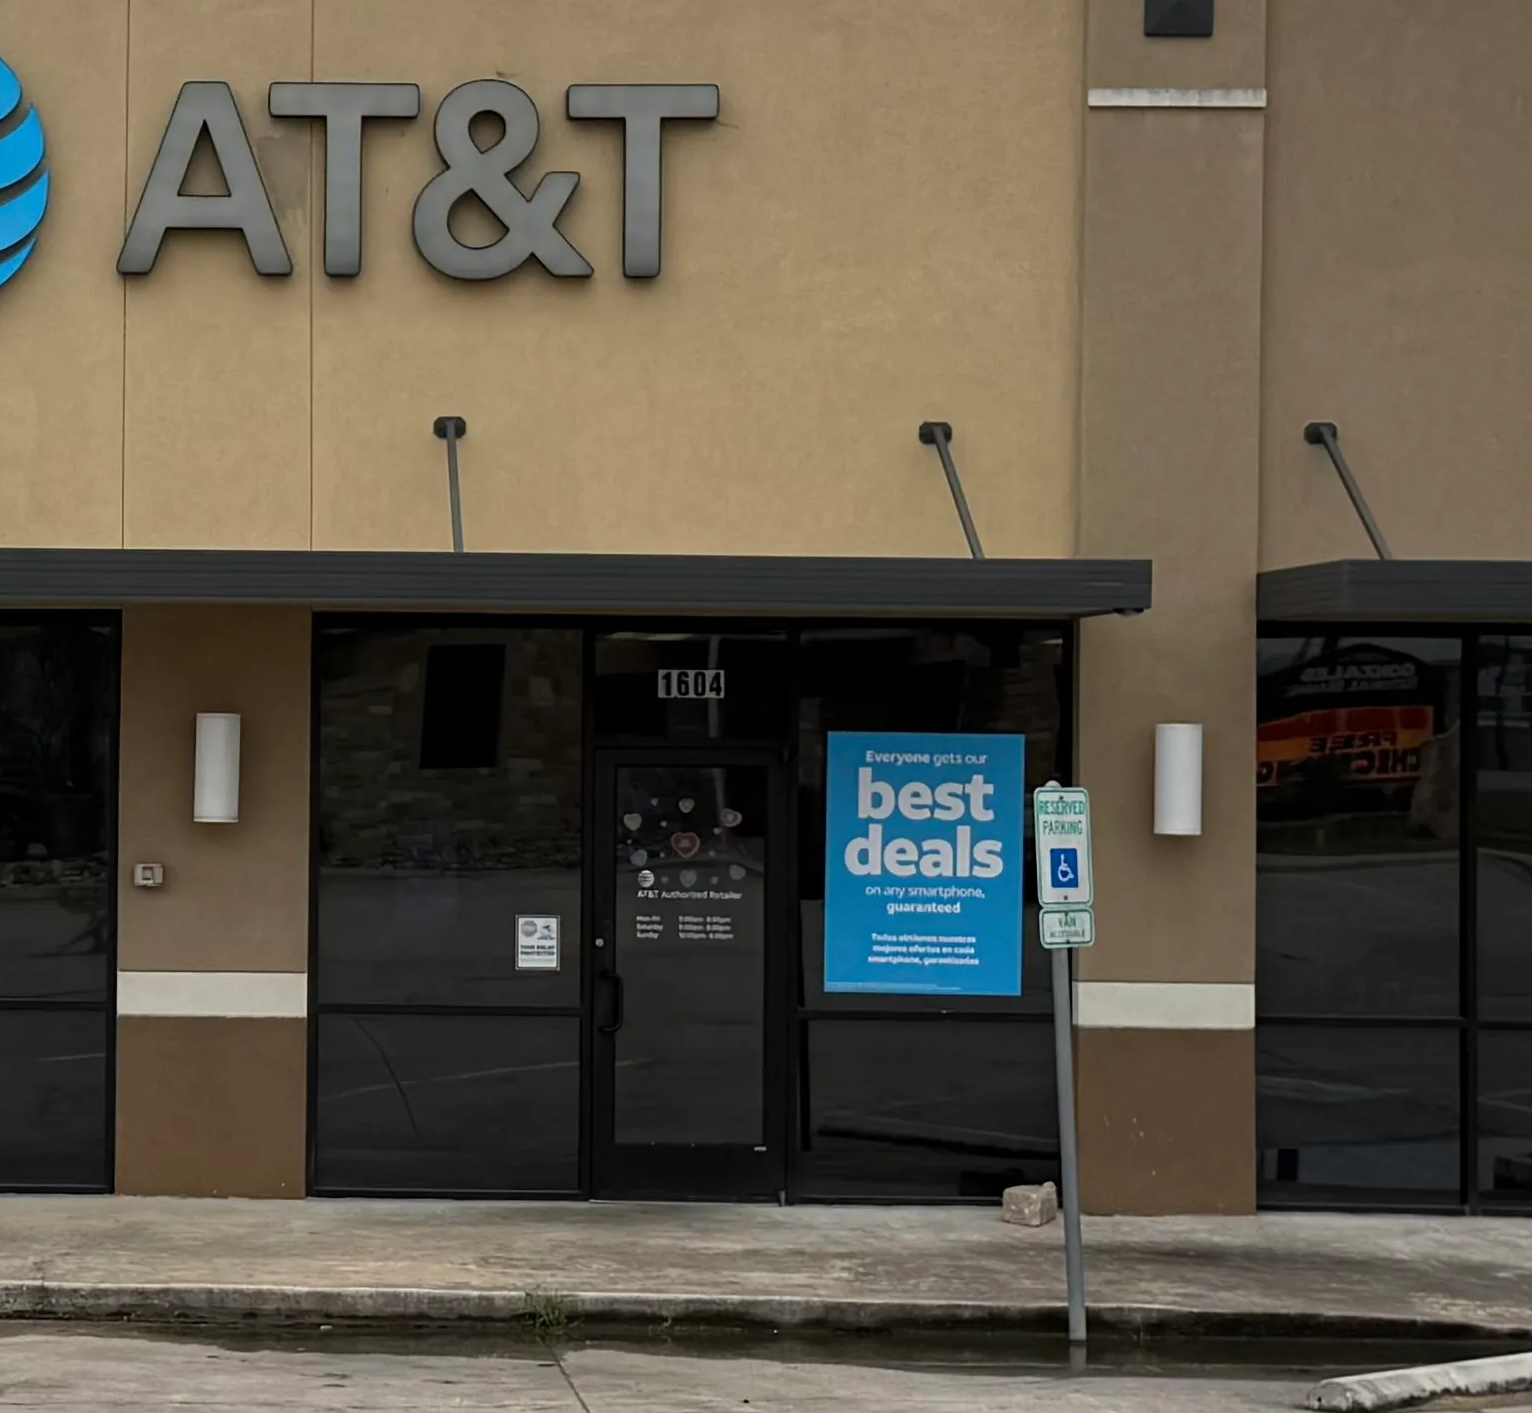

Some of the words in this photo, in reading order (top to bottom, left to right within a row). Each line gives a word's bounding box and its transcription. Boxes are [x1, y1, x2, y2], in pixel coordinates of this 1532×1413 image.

[115, 78, 721, 283] AT&T
[661, 670, 723, 697] 1604
[865, 750, 931, 766] Everyone
[933, 753, 963, 767] gets
[965, 755, 988, 764] our
[857, 767, 995, 822] best
[1039, 800, 1085, 815] RESERVED
[1042, 820, 1084, 835] PARKING
[844, 823, 1004, 878] deals
[637, 889, 659, 899] AT&T
[661, 890, 708, 899] Authorized
[709, 891, 743, 900] Retailer
[865, 886, 881, 896] on
[883, 886, 906, 899] any
[908, 885, 986, 900] smartphone,
[886, 901, 961, 915] guaranteed
[1058, 915, 1077, 928] VAN
